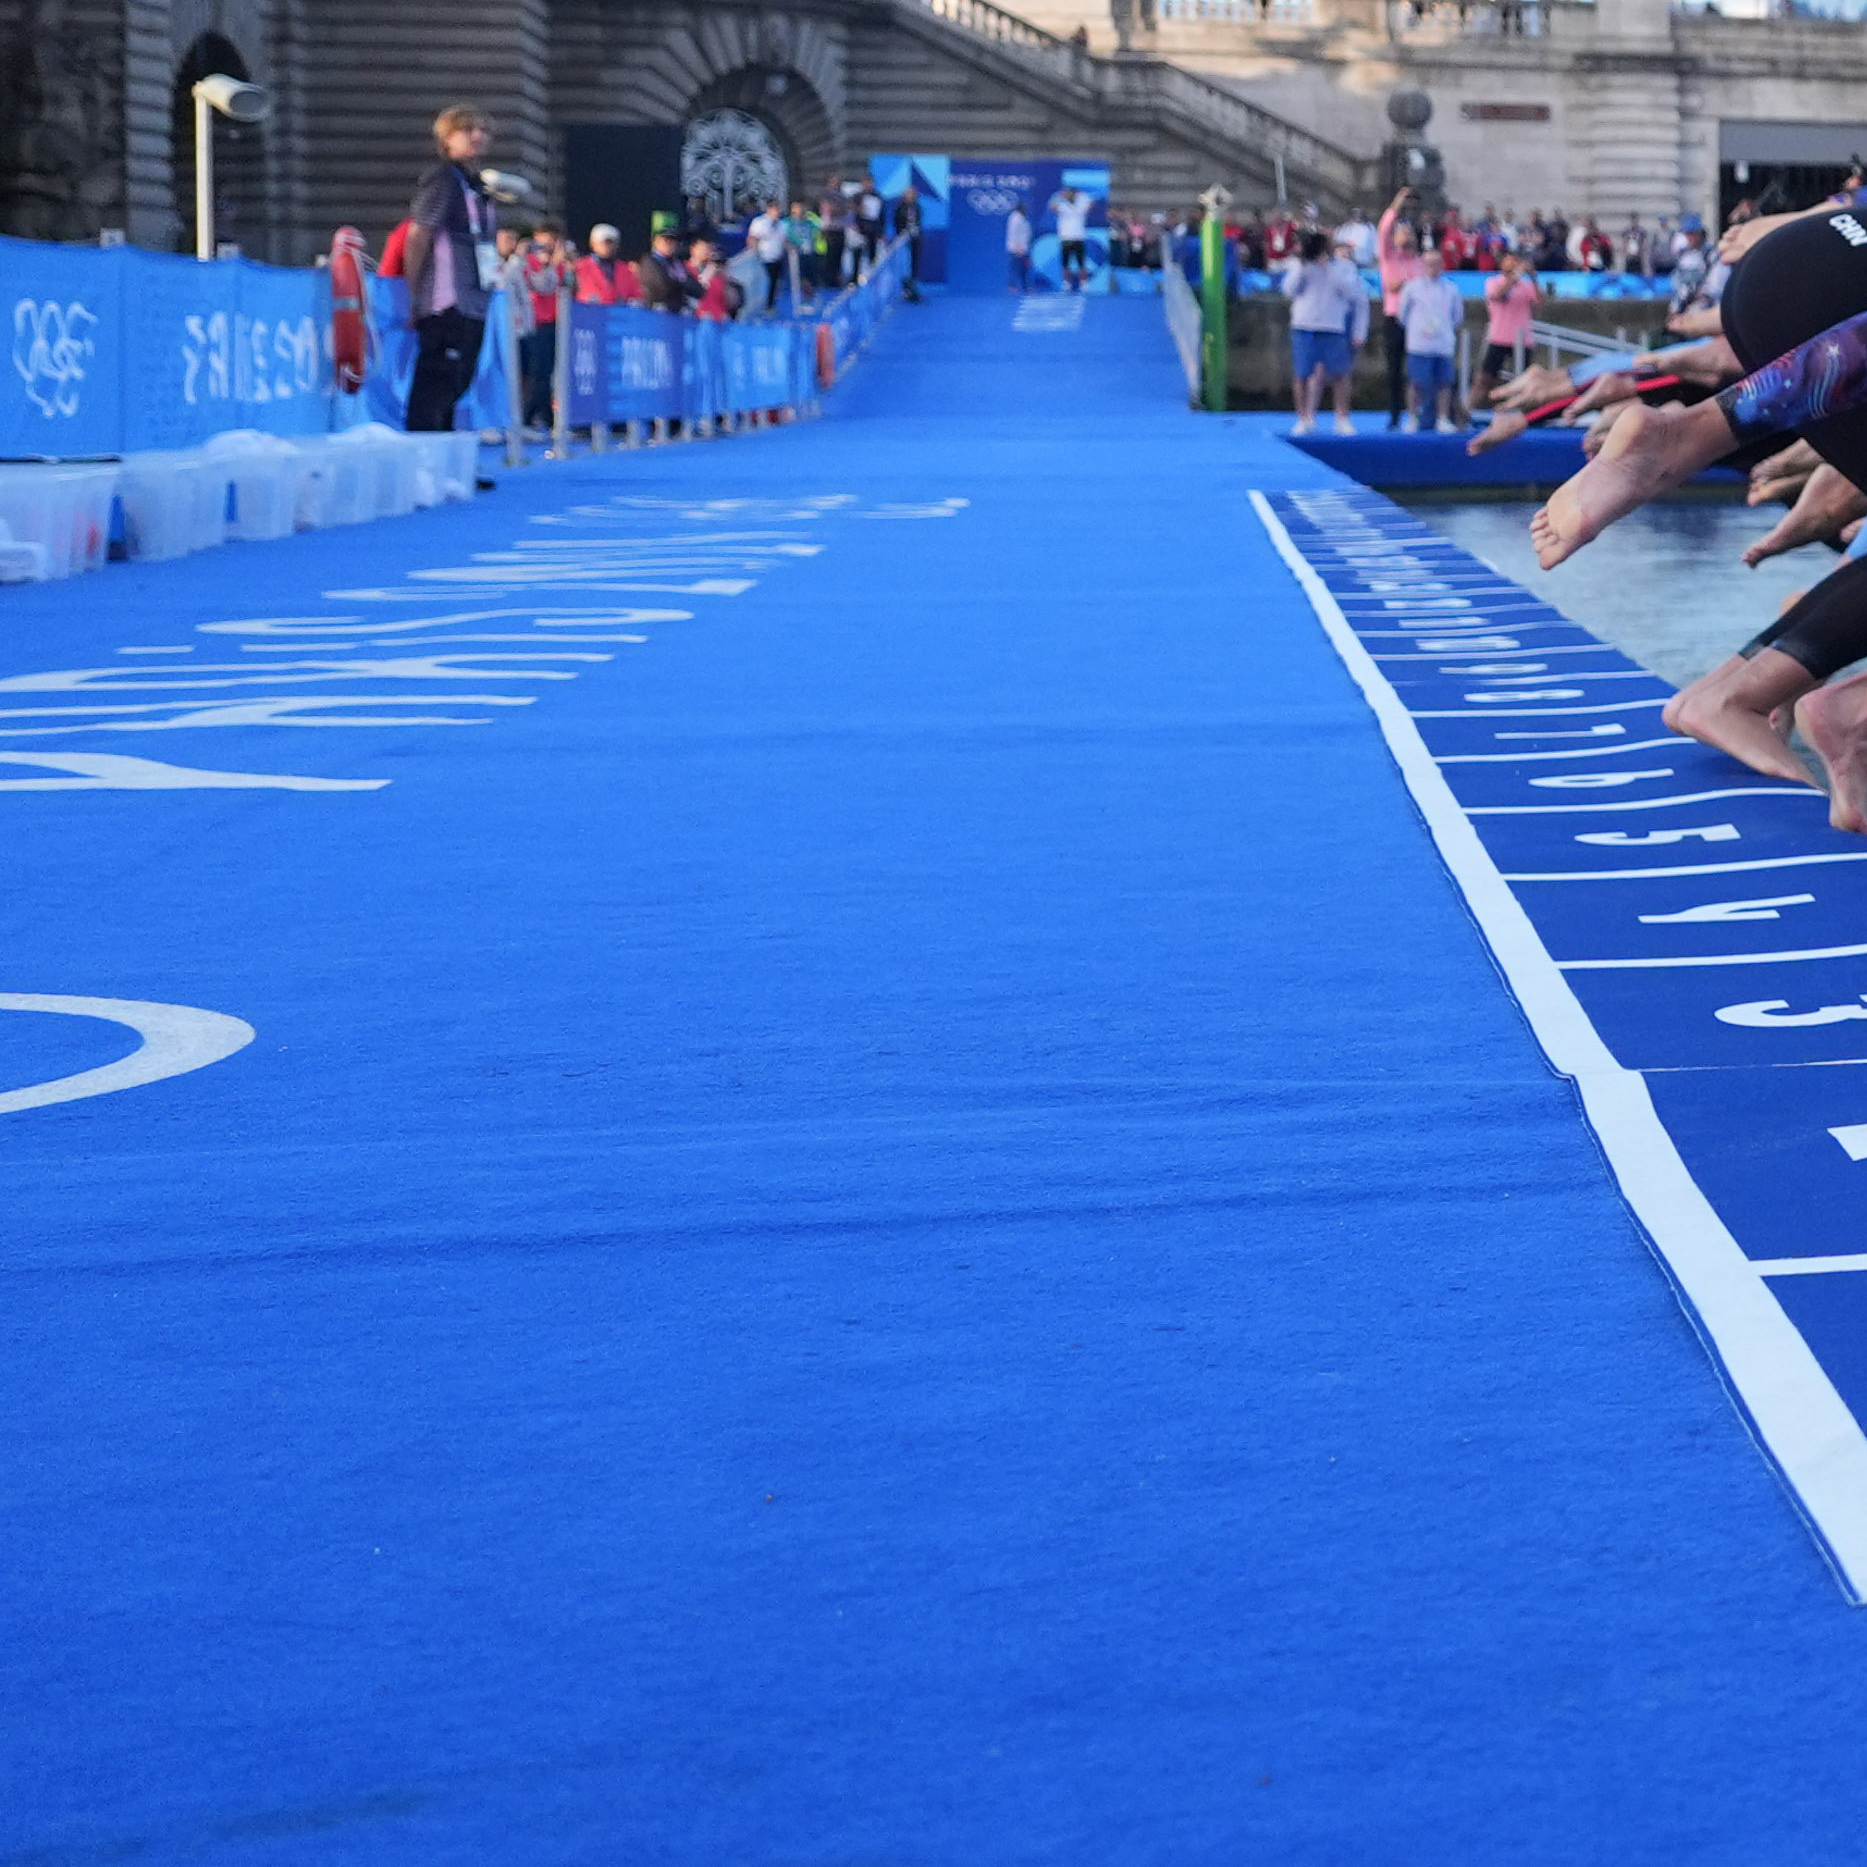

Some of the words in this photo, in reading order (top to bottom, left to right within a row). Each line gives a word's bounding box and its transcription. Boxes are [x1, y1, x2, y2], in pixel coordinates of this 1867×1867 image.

[1415, 636, 1521, 651] 10
[1439, 663, 1548, 674] 9
[1464, 688, 1585, 703] 8
[1494, 723, 1626, 740] 7
[1528, 768, 1674, 789] 6
[1574, 823, 1741, 846] 5
[1637, 893, 1816, 925] 4
